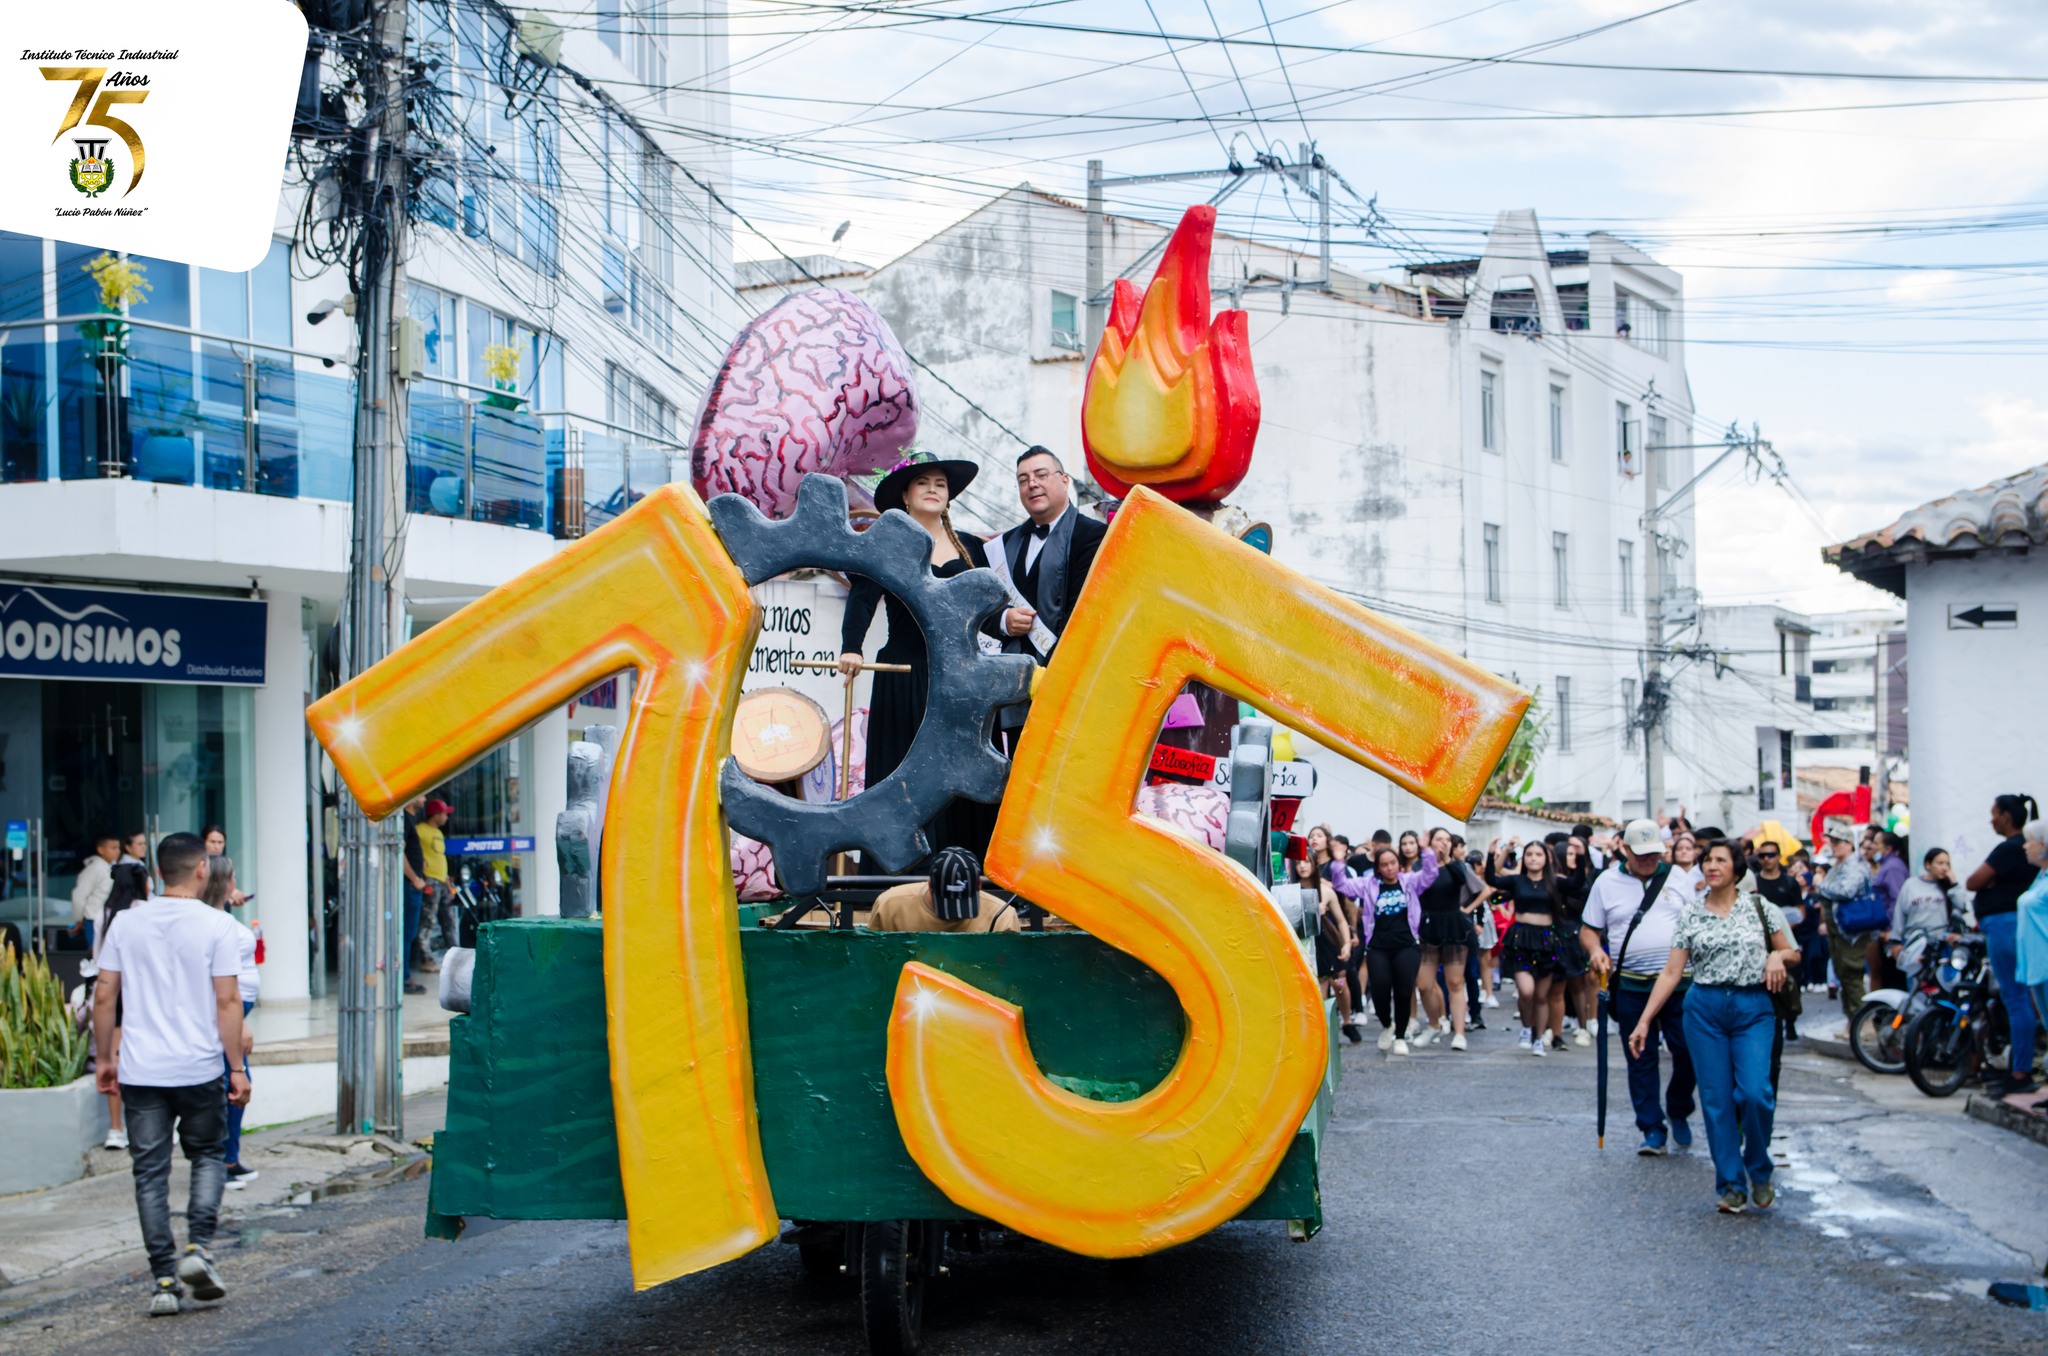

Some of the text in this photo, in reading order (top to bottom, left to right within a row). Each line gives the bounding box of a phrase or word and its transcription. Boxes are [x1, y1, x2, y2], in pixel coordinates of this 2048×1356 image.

[0, 619, 181, 667] ODISIMOS
[186, 664, 264, 677] Distribuidor Exclusivo
